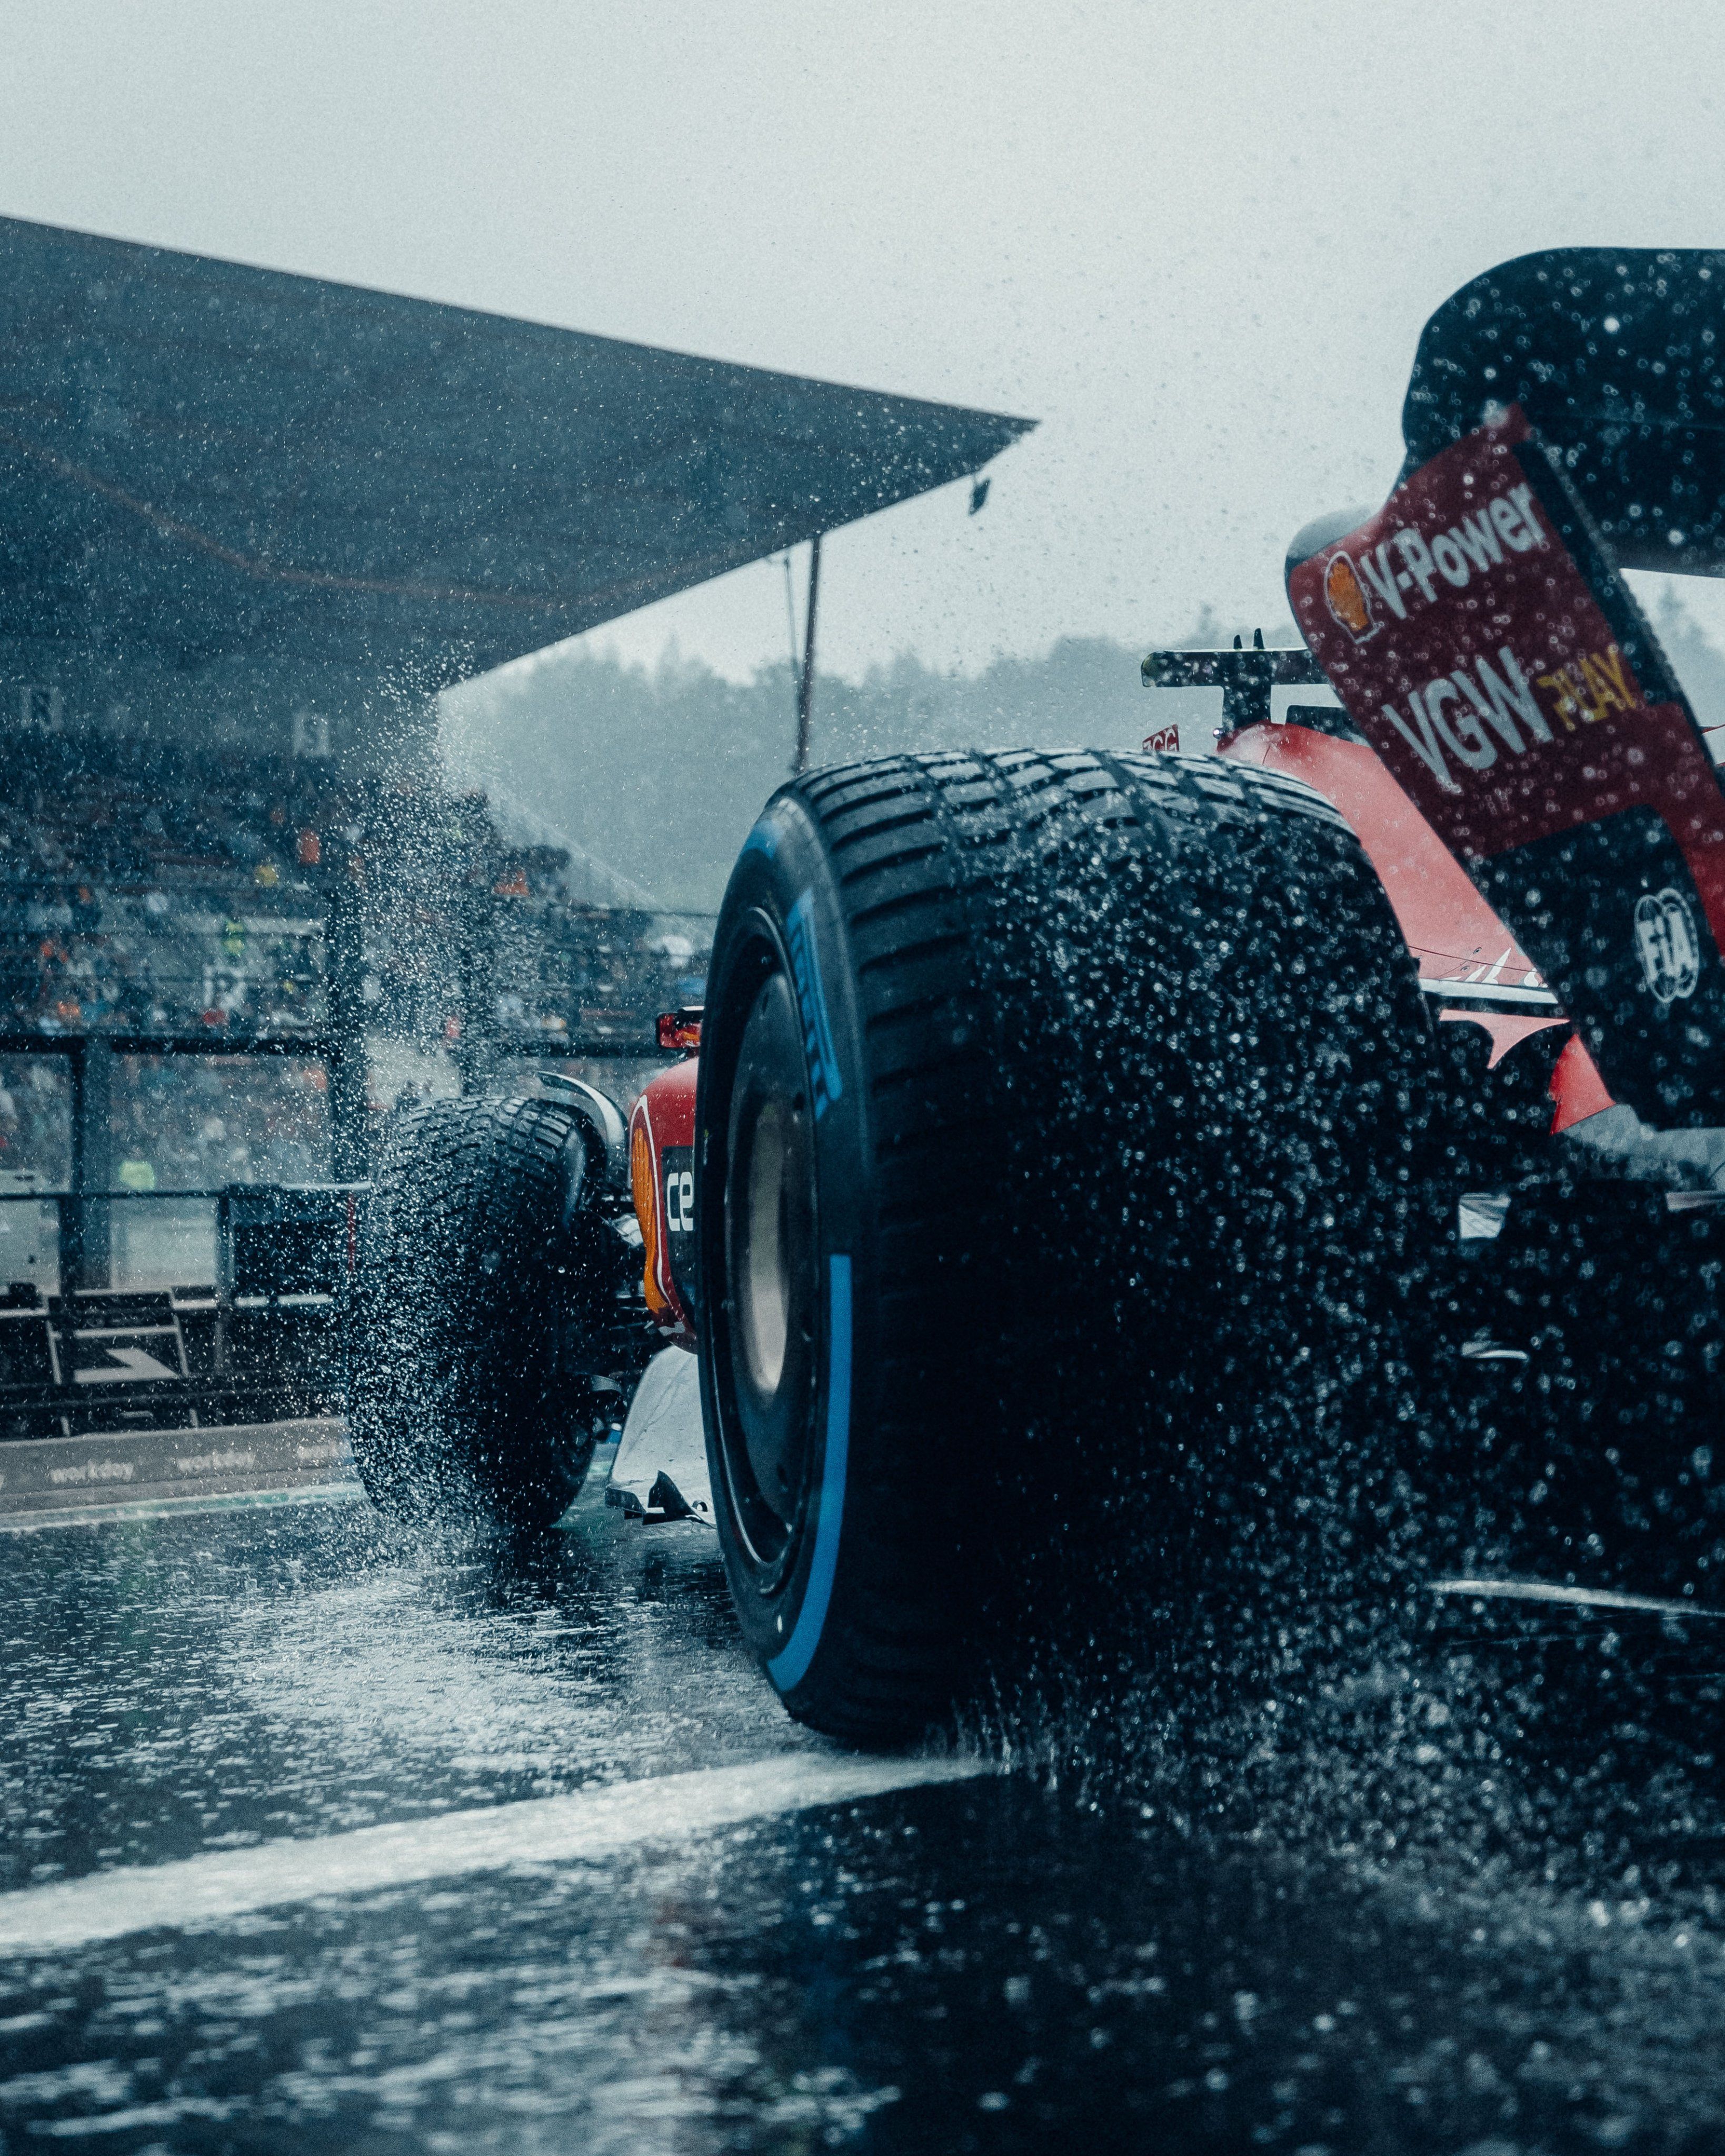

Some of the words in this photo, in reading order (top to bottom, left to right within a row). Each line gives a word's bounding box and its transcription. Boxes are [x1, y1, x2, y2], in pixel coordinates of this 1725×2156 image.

[1360, 483, 1546, 620] V-Power
[1381, 645, 1554, 794] VGW
[1537, 644, 1637, 733] PLAY
